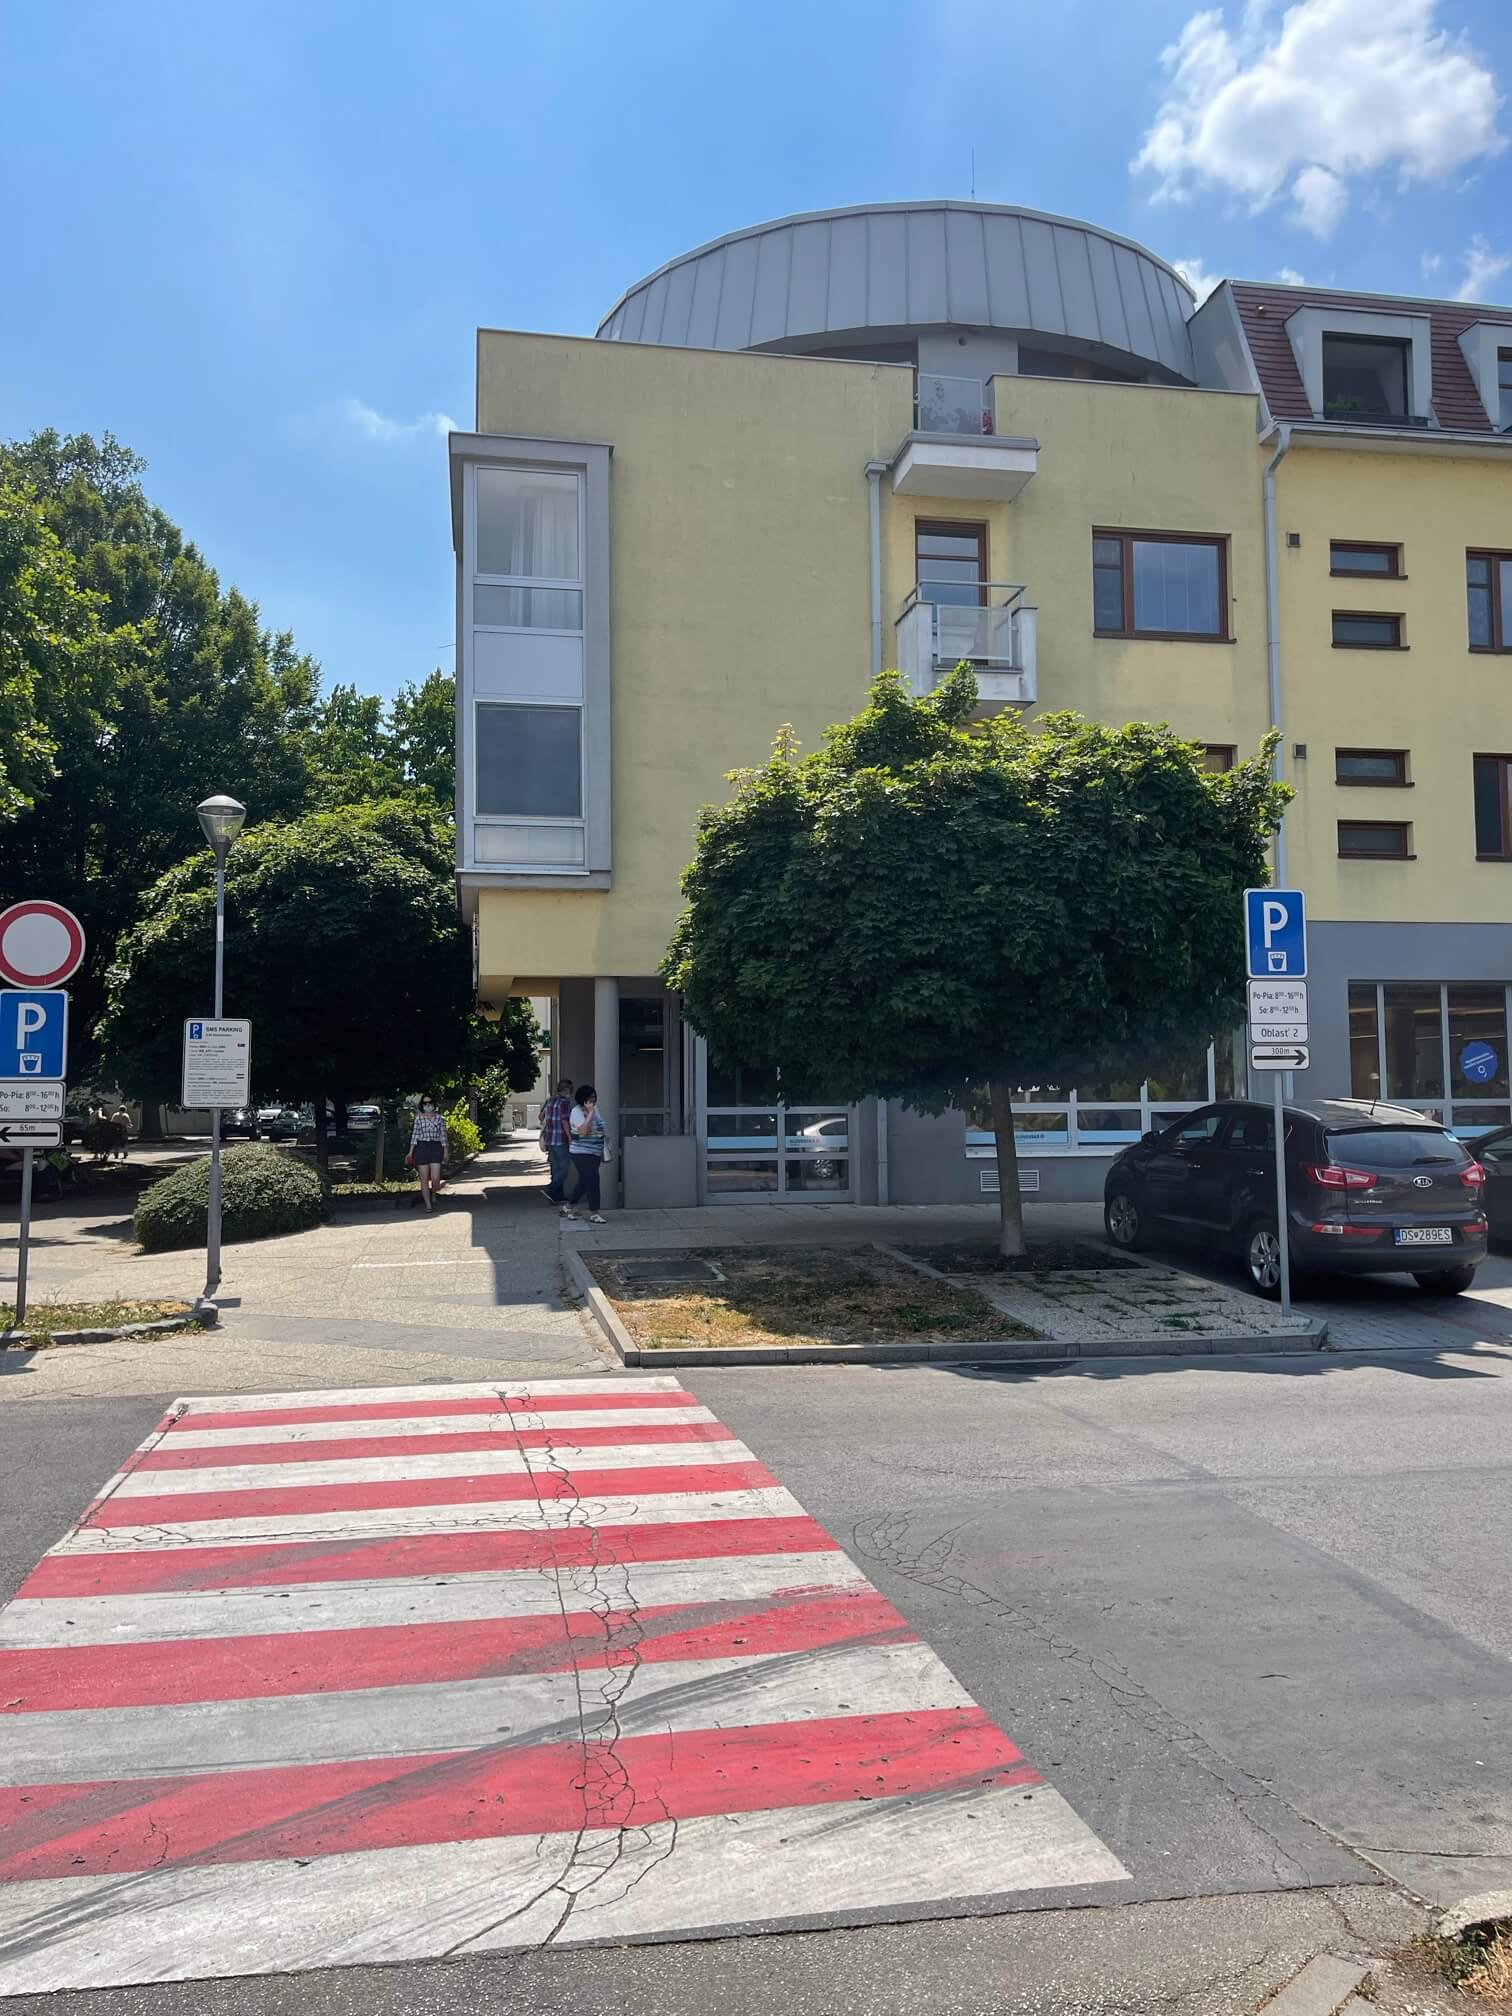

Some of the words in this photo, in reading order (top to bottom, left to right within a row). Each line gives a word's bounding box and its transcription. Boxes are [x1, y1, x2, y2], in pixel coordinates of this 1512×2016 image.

[1263, 901, 1288, 948] P
[16, 1002, 46, 1050] P
[1293, 1028, 1298, 1037] 2
[1271, 1047, 1289, 1055] 300m
